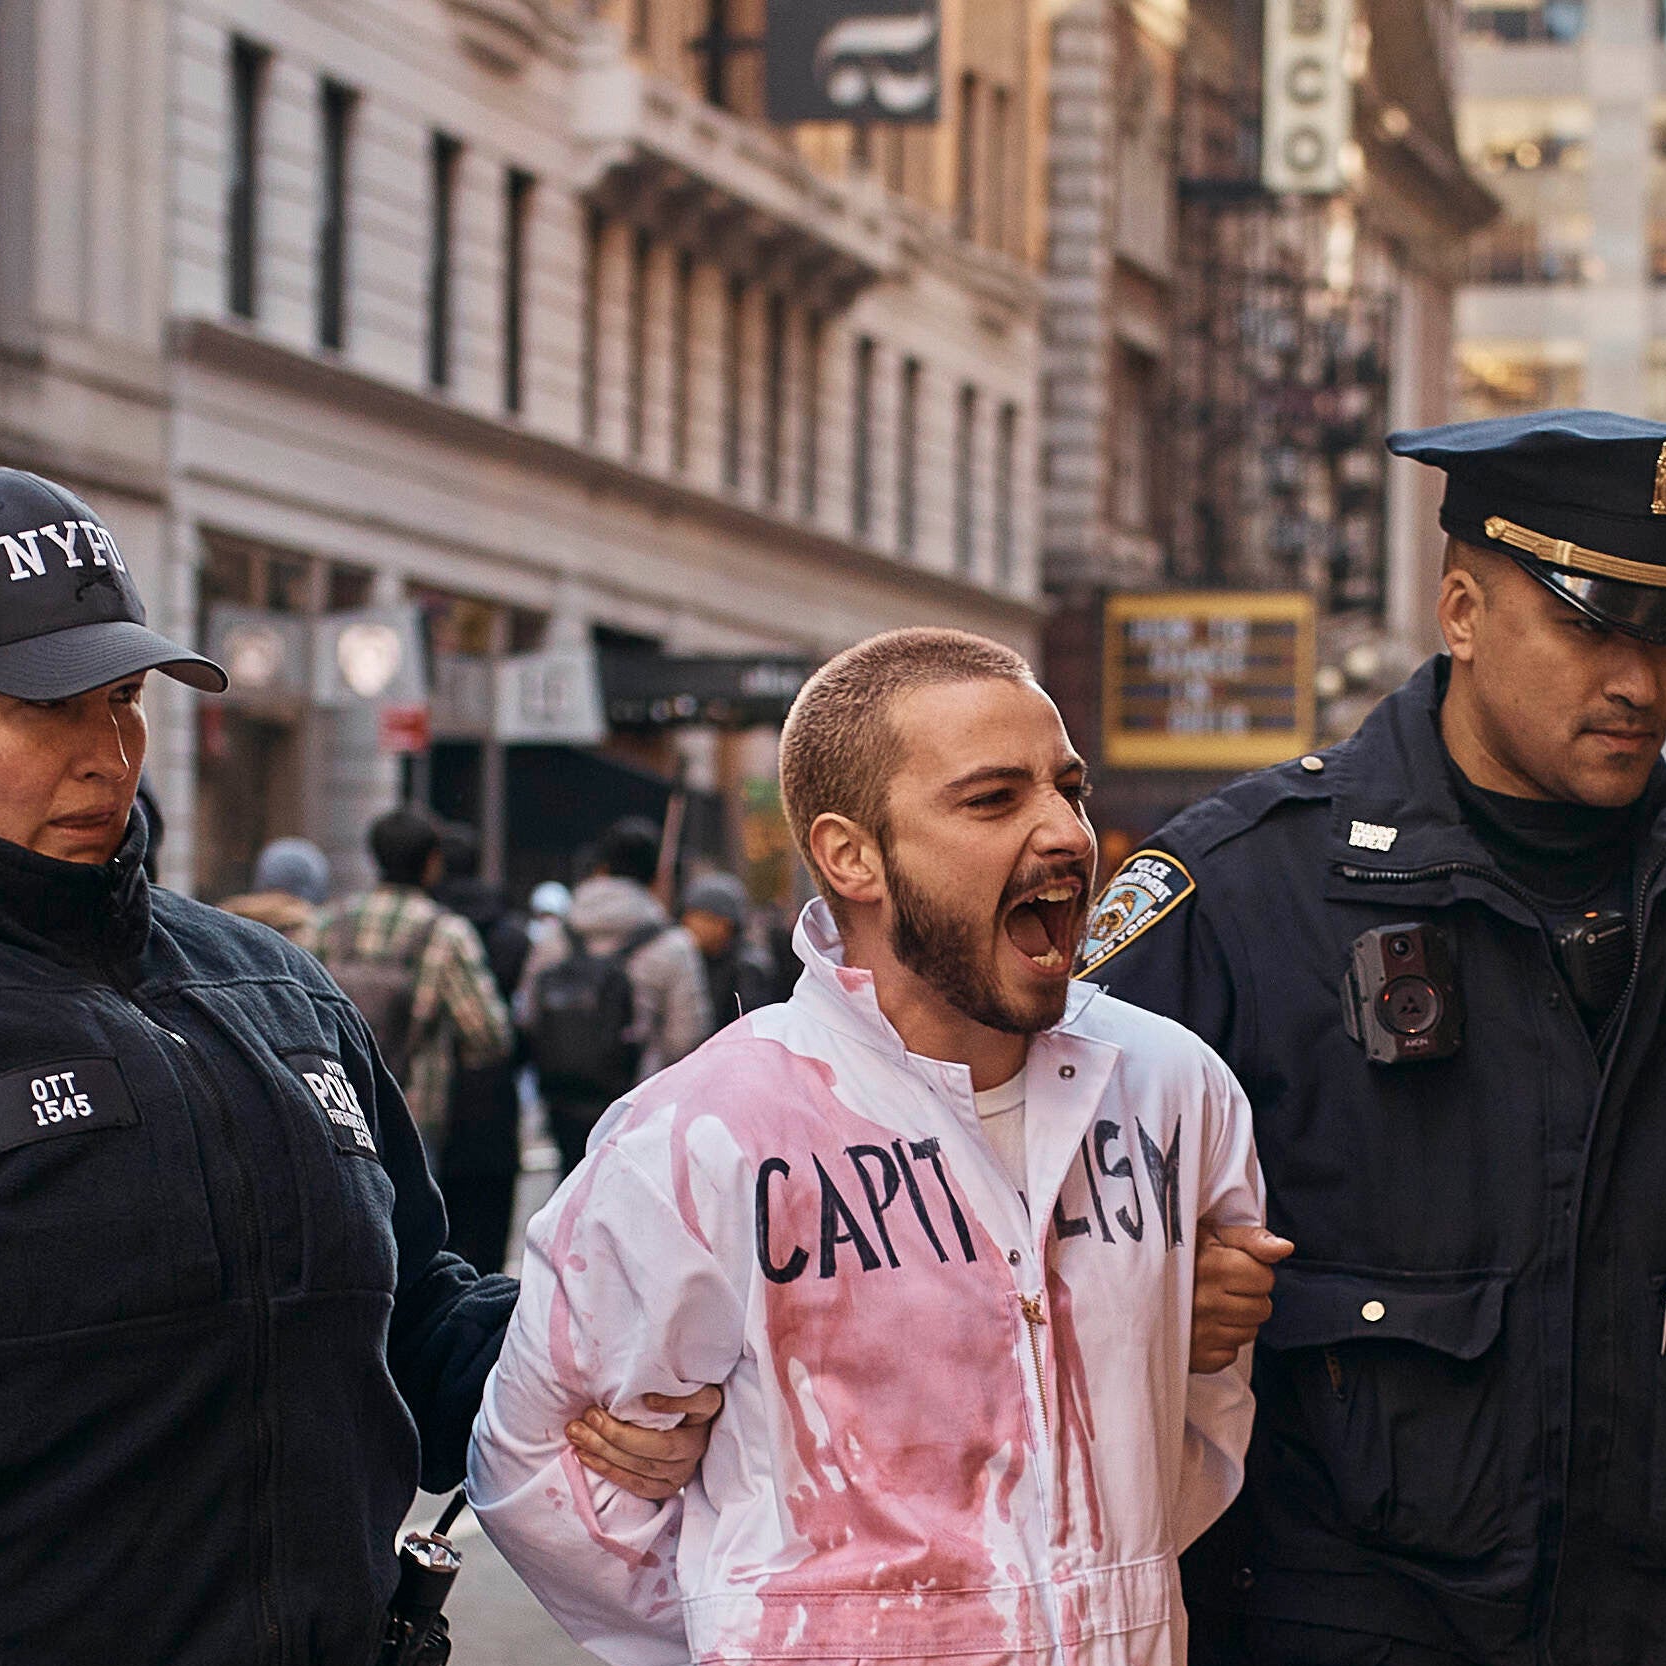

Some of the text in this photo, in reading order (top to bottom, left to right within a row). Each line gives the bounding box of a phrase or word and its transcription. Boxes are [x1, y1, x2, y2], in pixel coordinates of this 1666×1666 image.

[1116, 908, 1159, 942] YORK
[30, 1071, 76, 1102] OTT
[31, 1094, 94, 1127] 1545
[755, 1112, 1185, 1285] CAPITLISM
